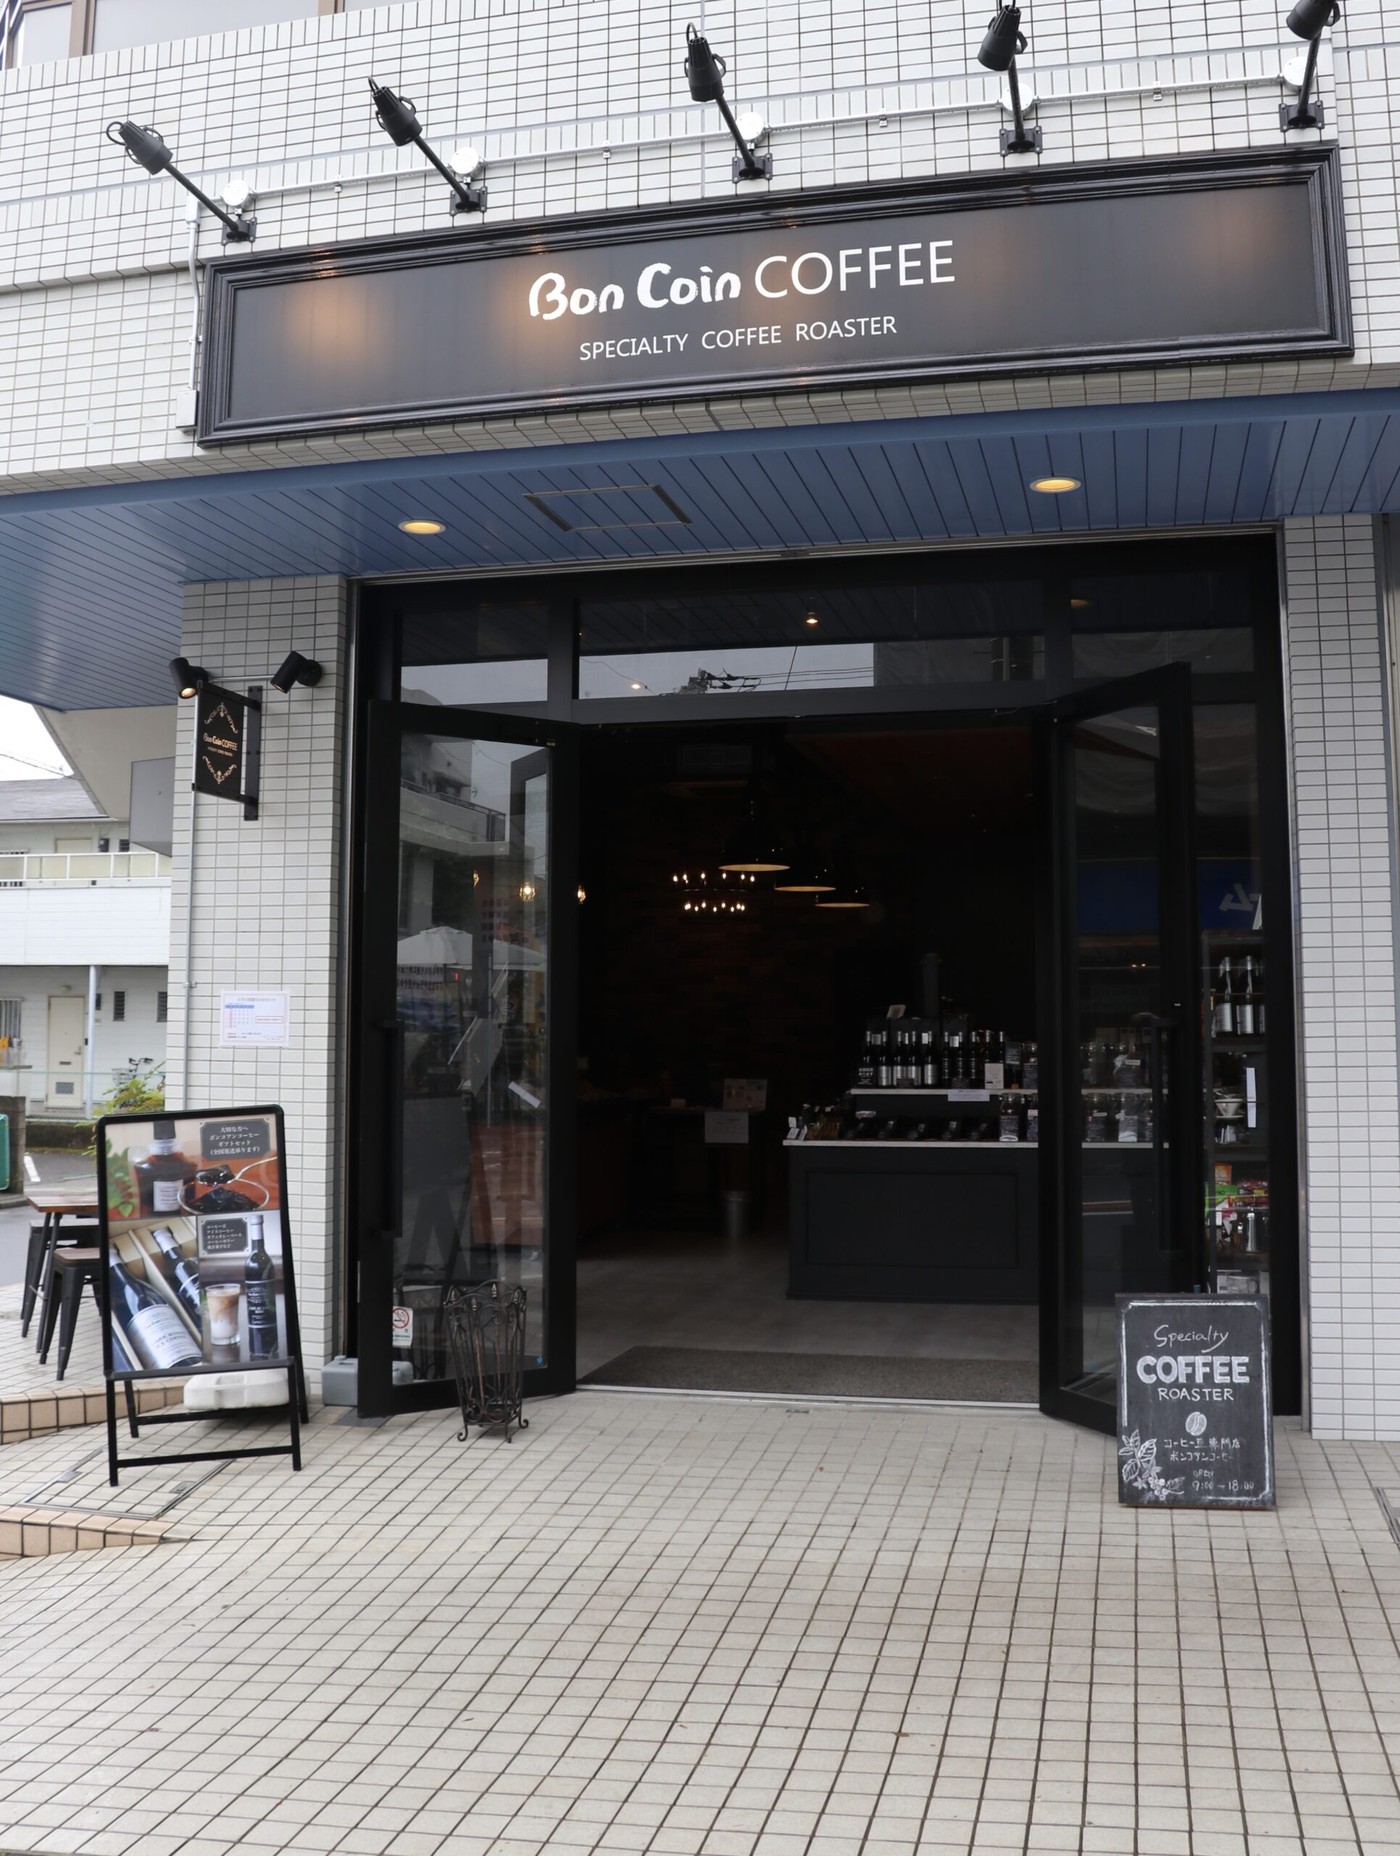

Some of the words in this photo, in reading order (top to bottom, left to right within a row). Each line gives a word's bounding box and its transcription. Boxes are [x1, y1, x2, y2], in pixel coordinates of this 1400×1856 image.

[529, 271, 625, 321] Bon
[636, 262, 741, 309] Coin
[754, 239, 956, 299] COFFEE
[578, 333, 690, 361] SPECIALTY
[701, 325, 782, 350] COFFEE
[795, 315, 898, 342] ROASTER
[1153, 1324, 1230, 1354] Specialty
[1136, 1355, 1250, 1385] COFFEE
[1157, 1387, 1235, 1402] ROASTER
